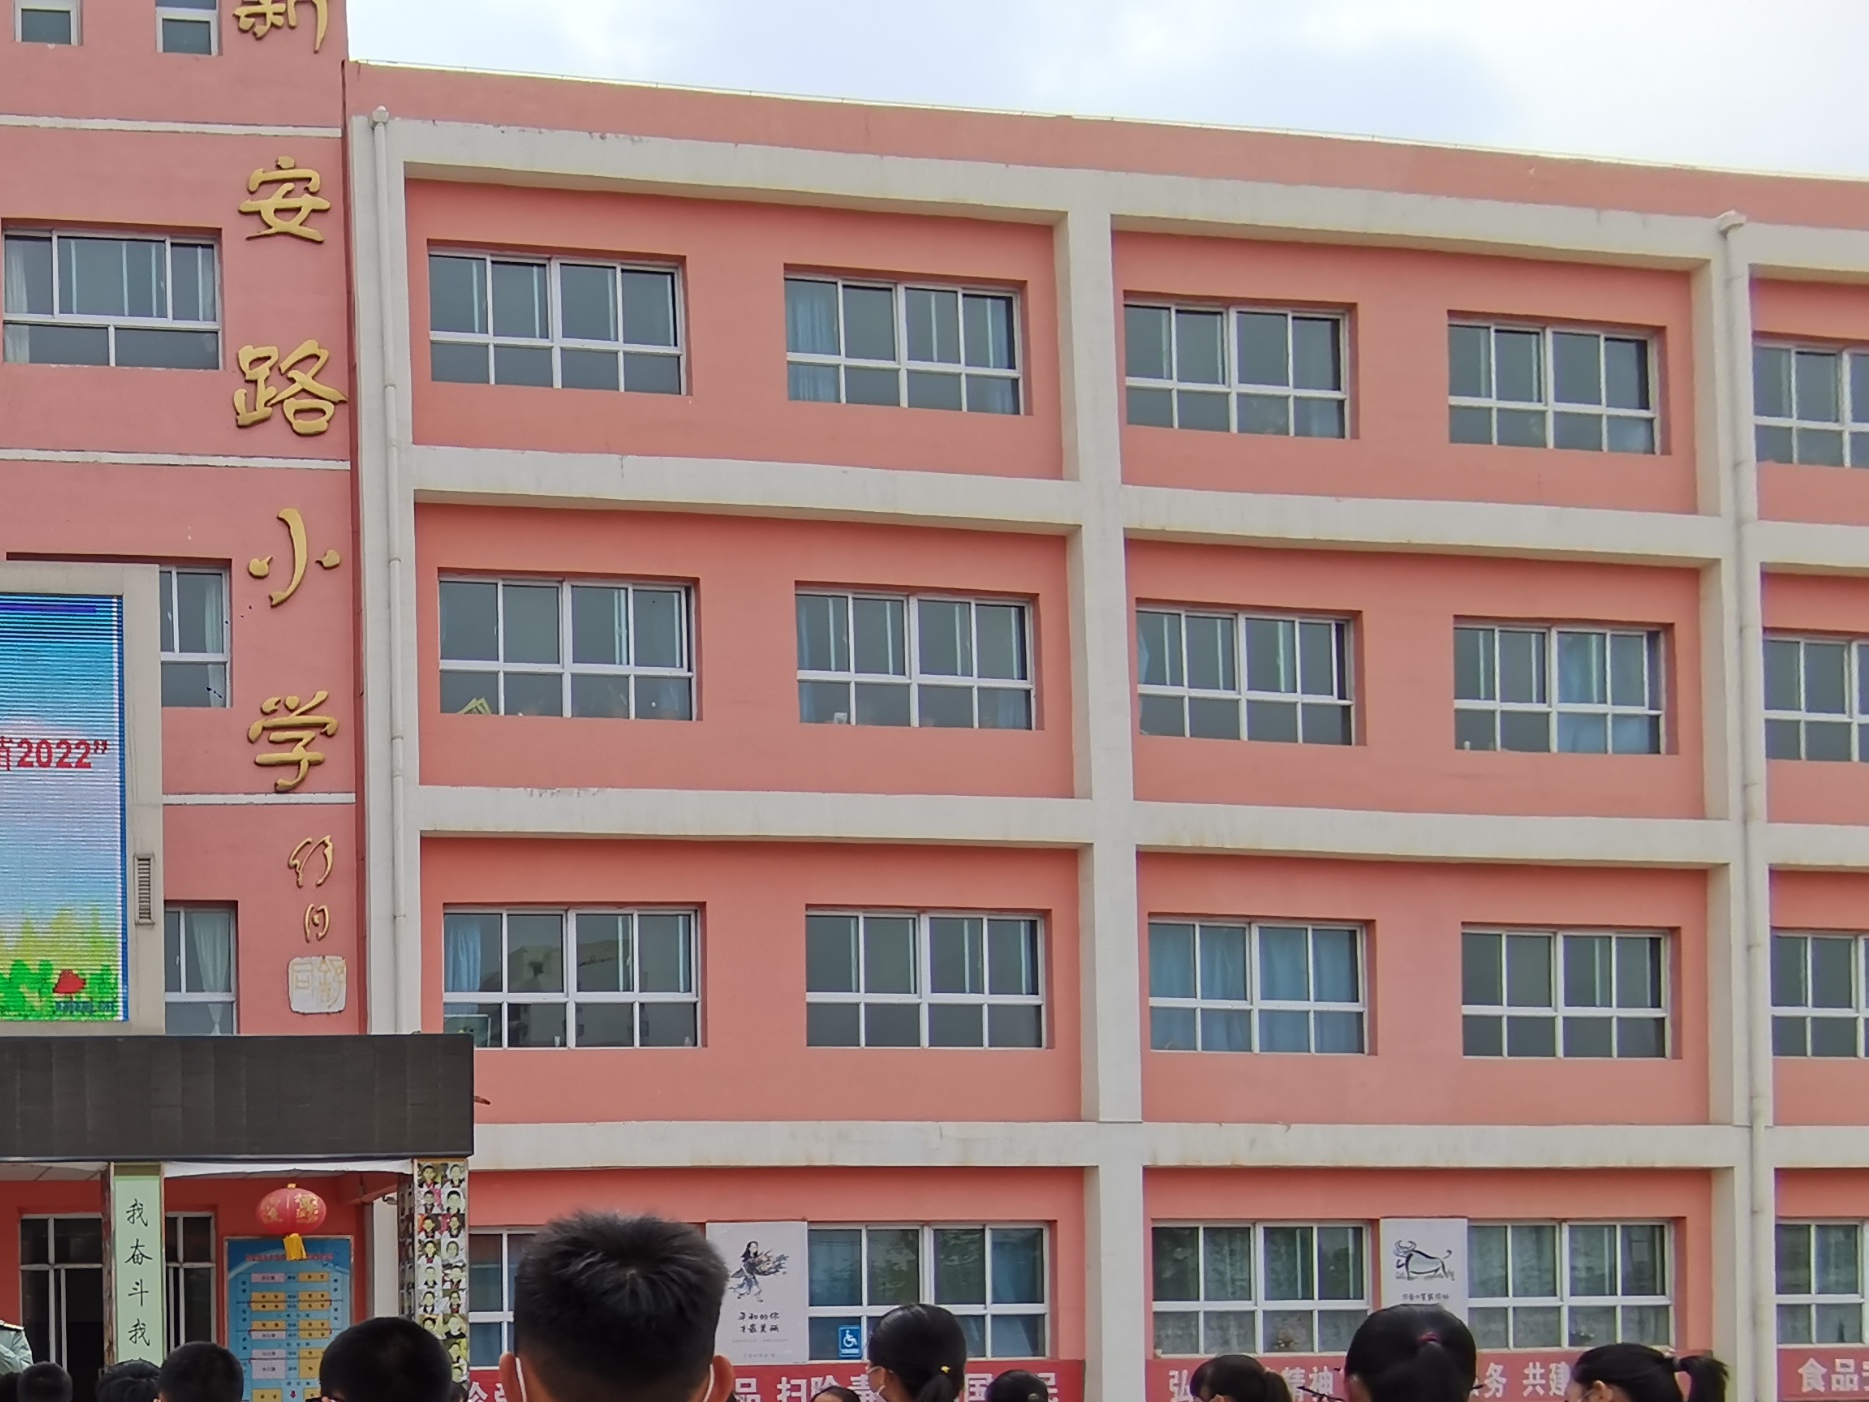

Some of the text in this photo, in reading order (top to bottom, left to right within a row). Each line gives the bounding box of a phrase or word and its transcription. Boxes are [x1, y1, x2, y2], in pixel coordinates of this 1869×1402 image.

[124, 1198, 153, 1350] 我奋斗我
[1797, 1357, 1869, 1393] 食品
